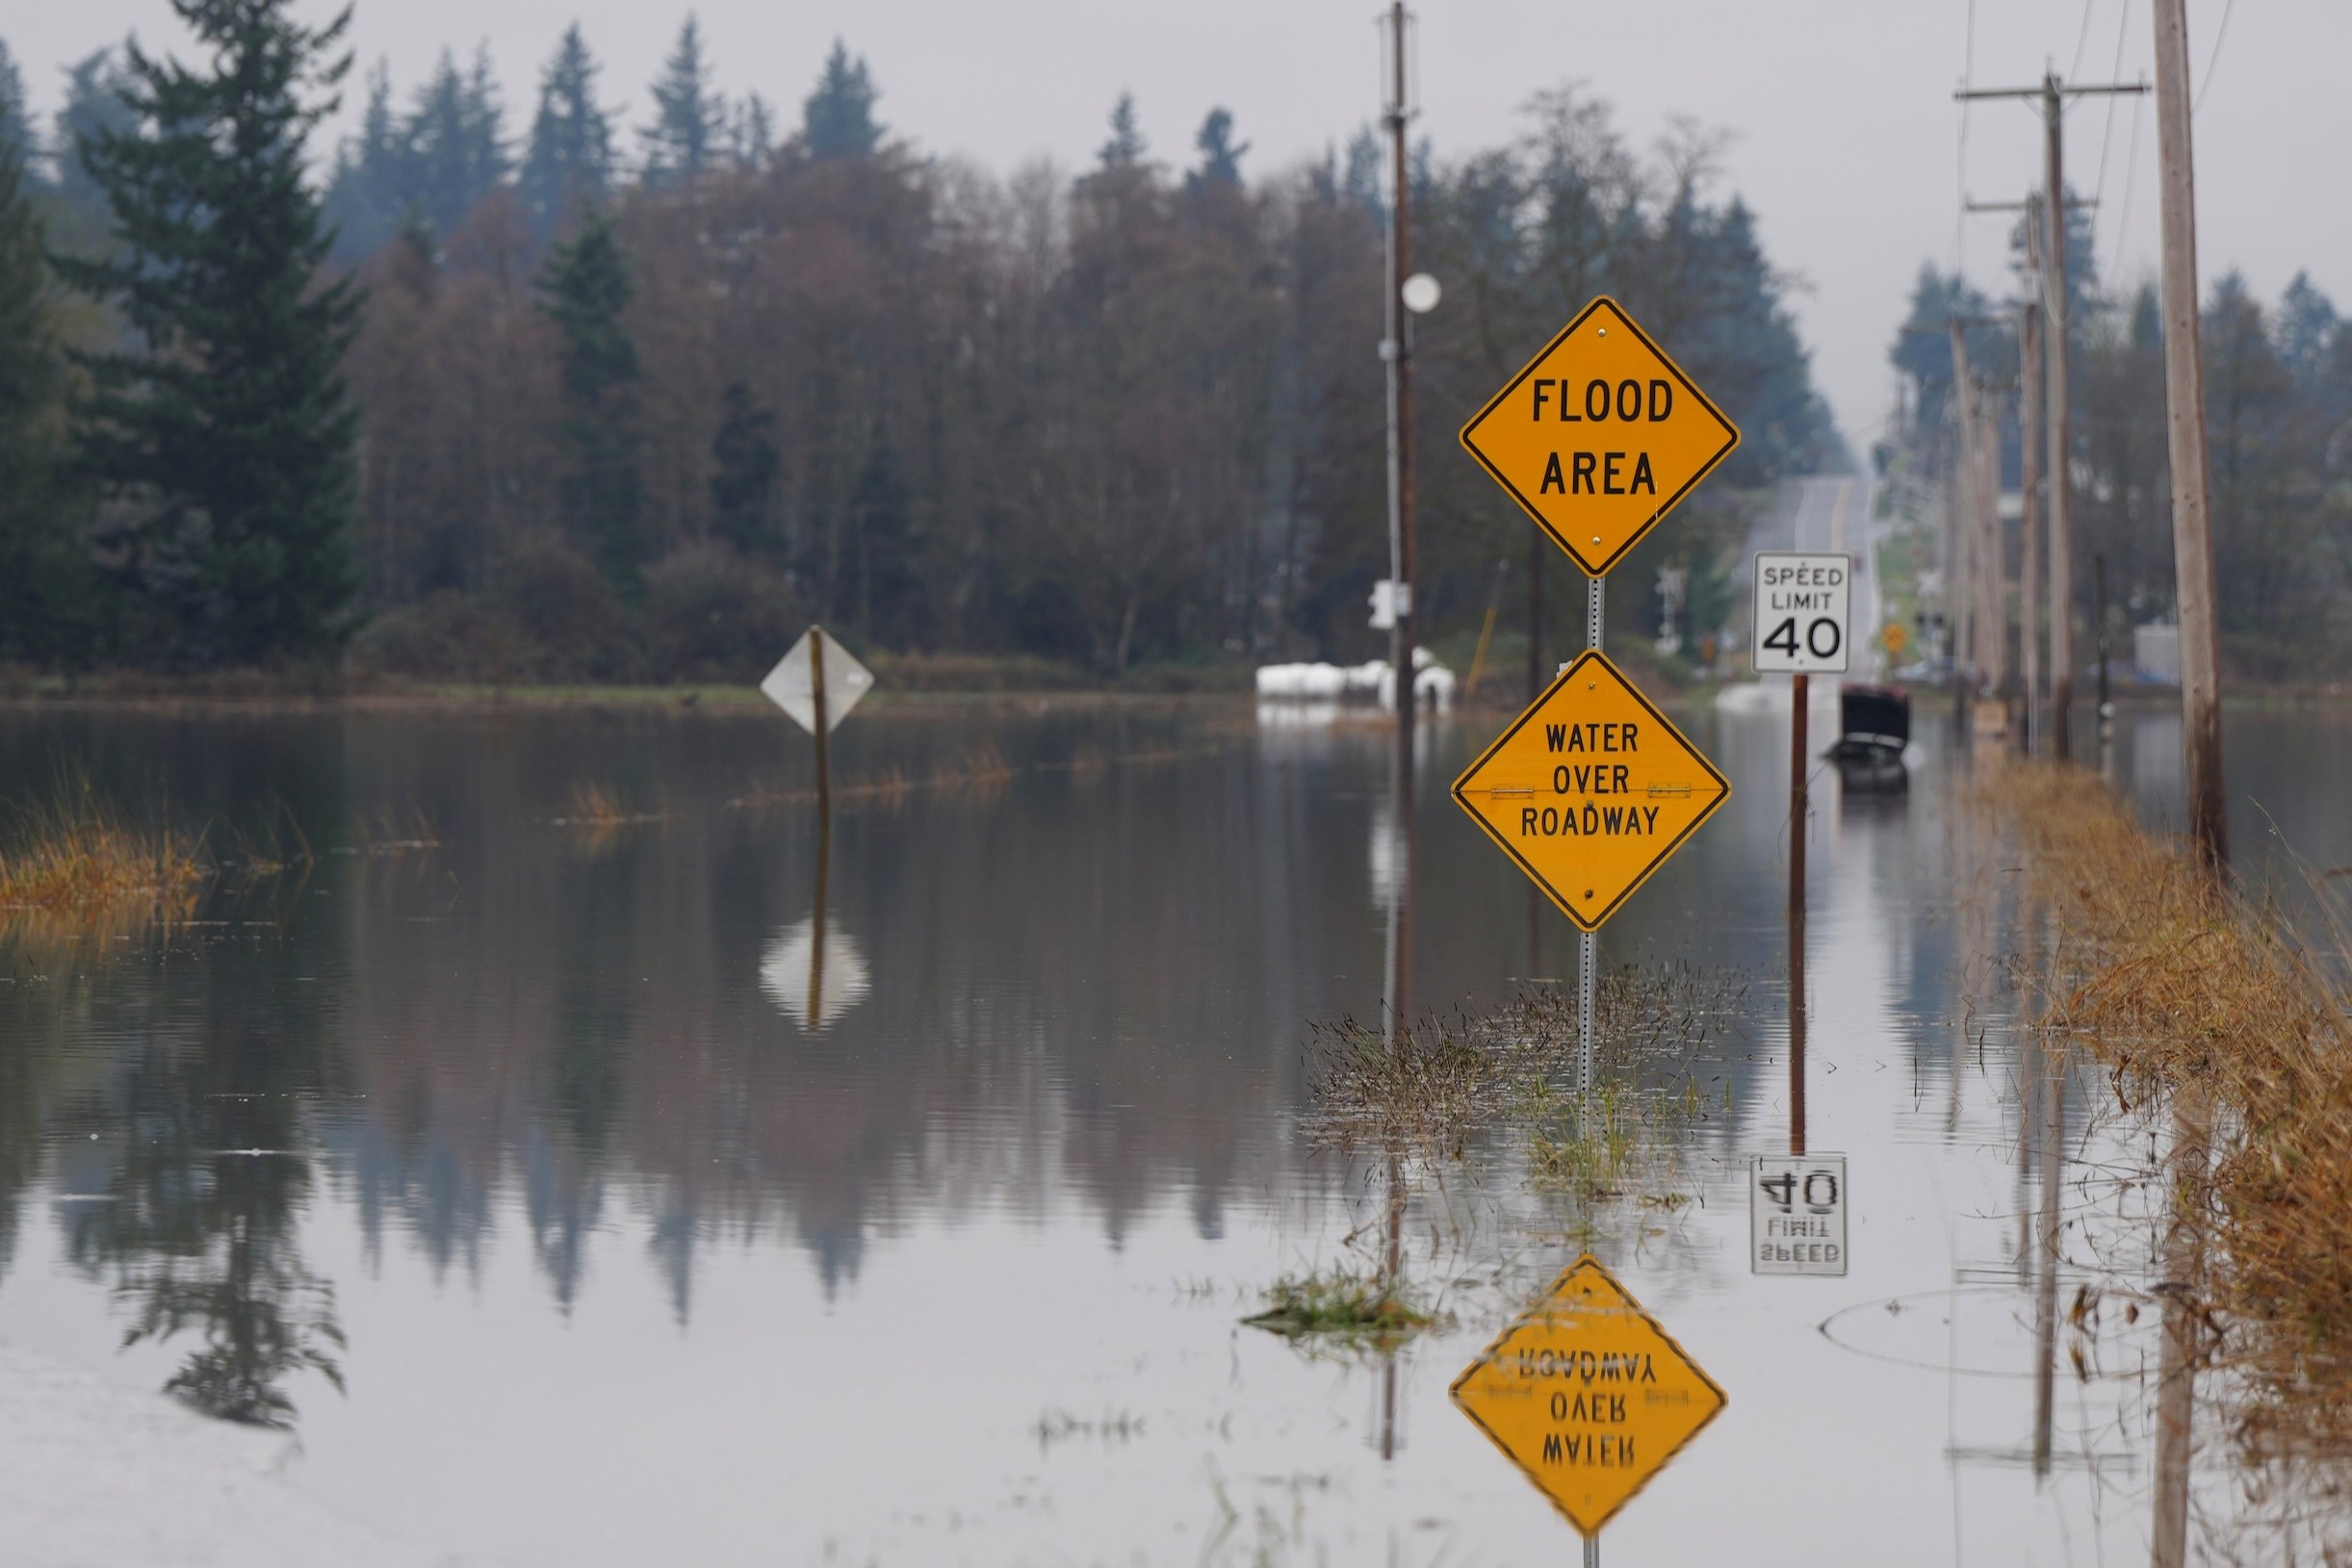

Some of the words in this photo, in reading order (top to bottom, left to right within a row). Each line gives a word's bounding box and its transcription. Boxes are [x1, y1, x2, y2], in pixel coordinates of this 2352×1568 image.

[1534, 378, 1672, 423] FLOOD
[1539, 451, 1656, 495] AREA
[1764, 566, 1843, 586] SPEED
[1770, 592, 1832, 610] LIMIT
[1762, 617, 1841, 659] 40
[1545, 723, 1639, 753] WATER
[1553, 764, 1629, 795] OVER
[1521, 806, 1660, 836] ROADWAY
